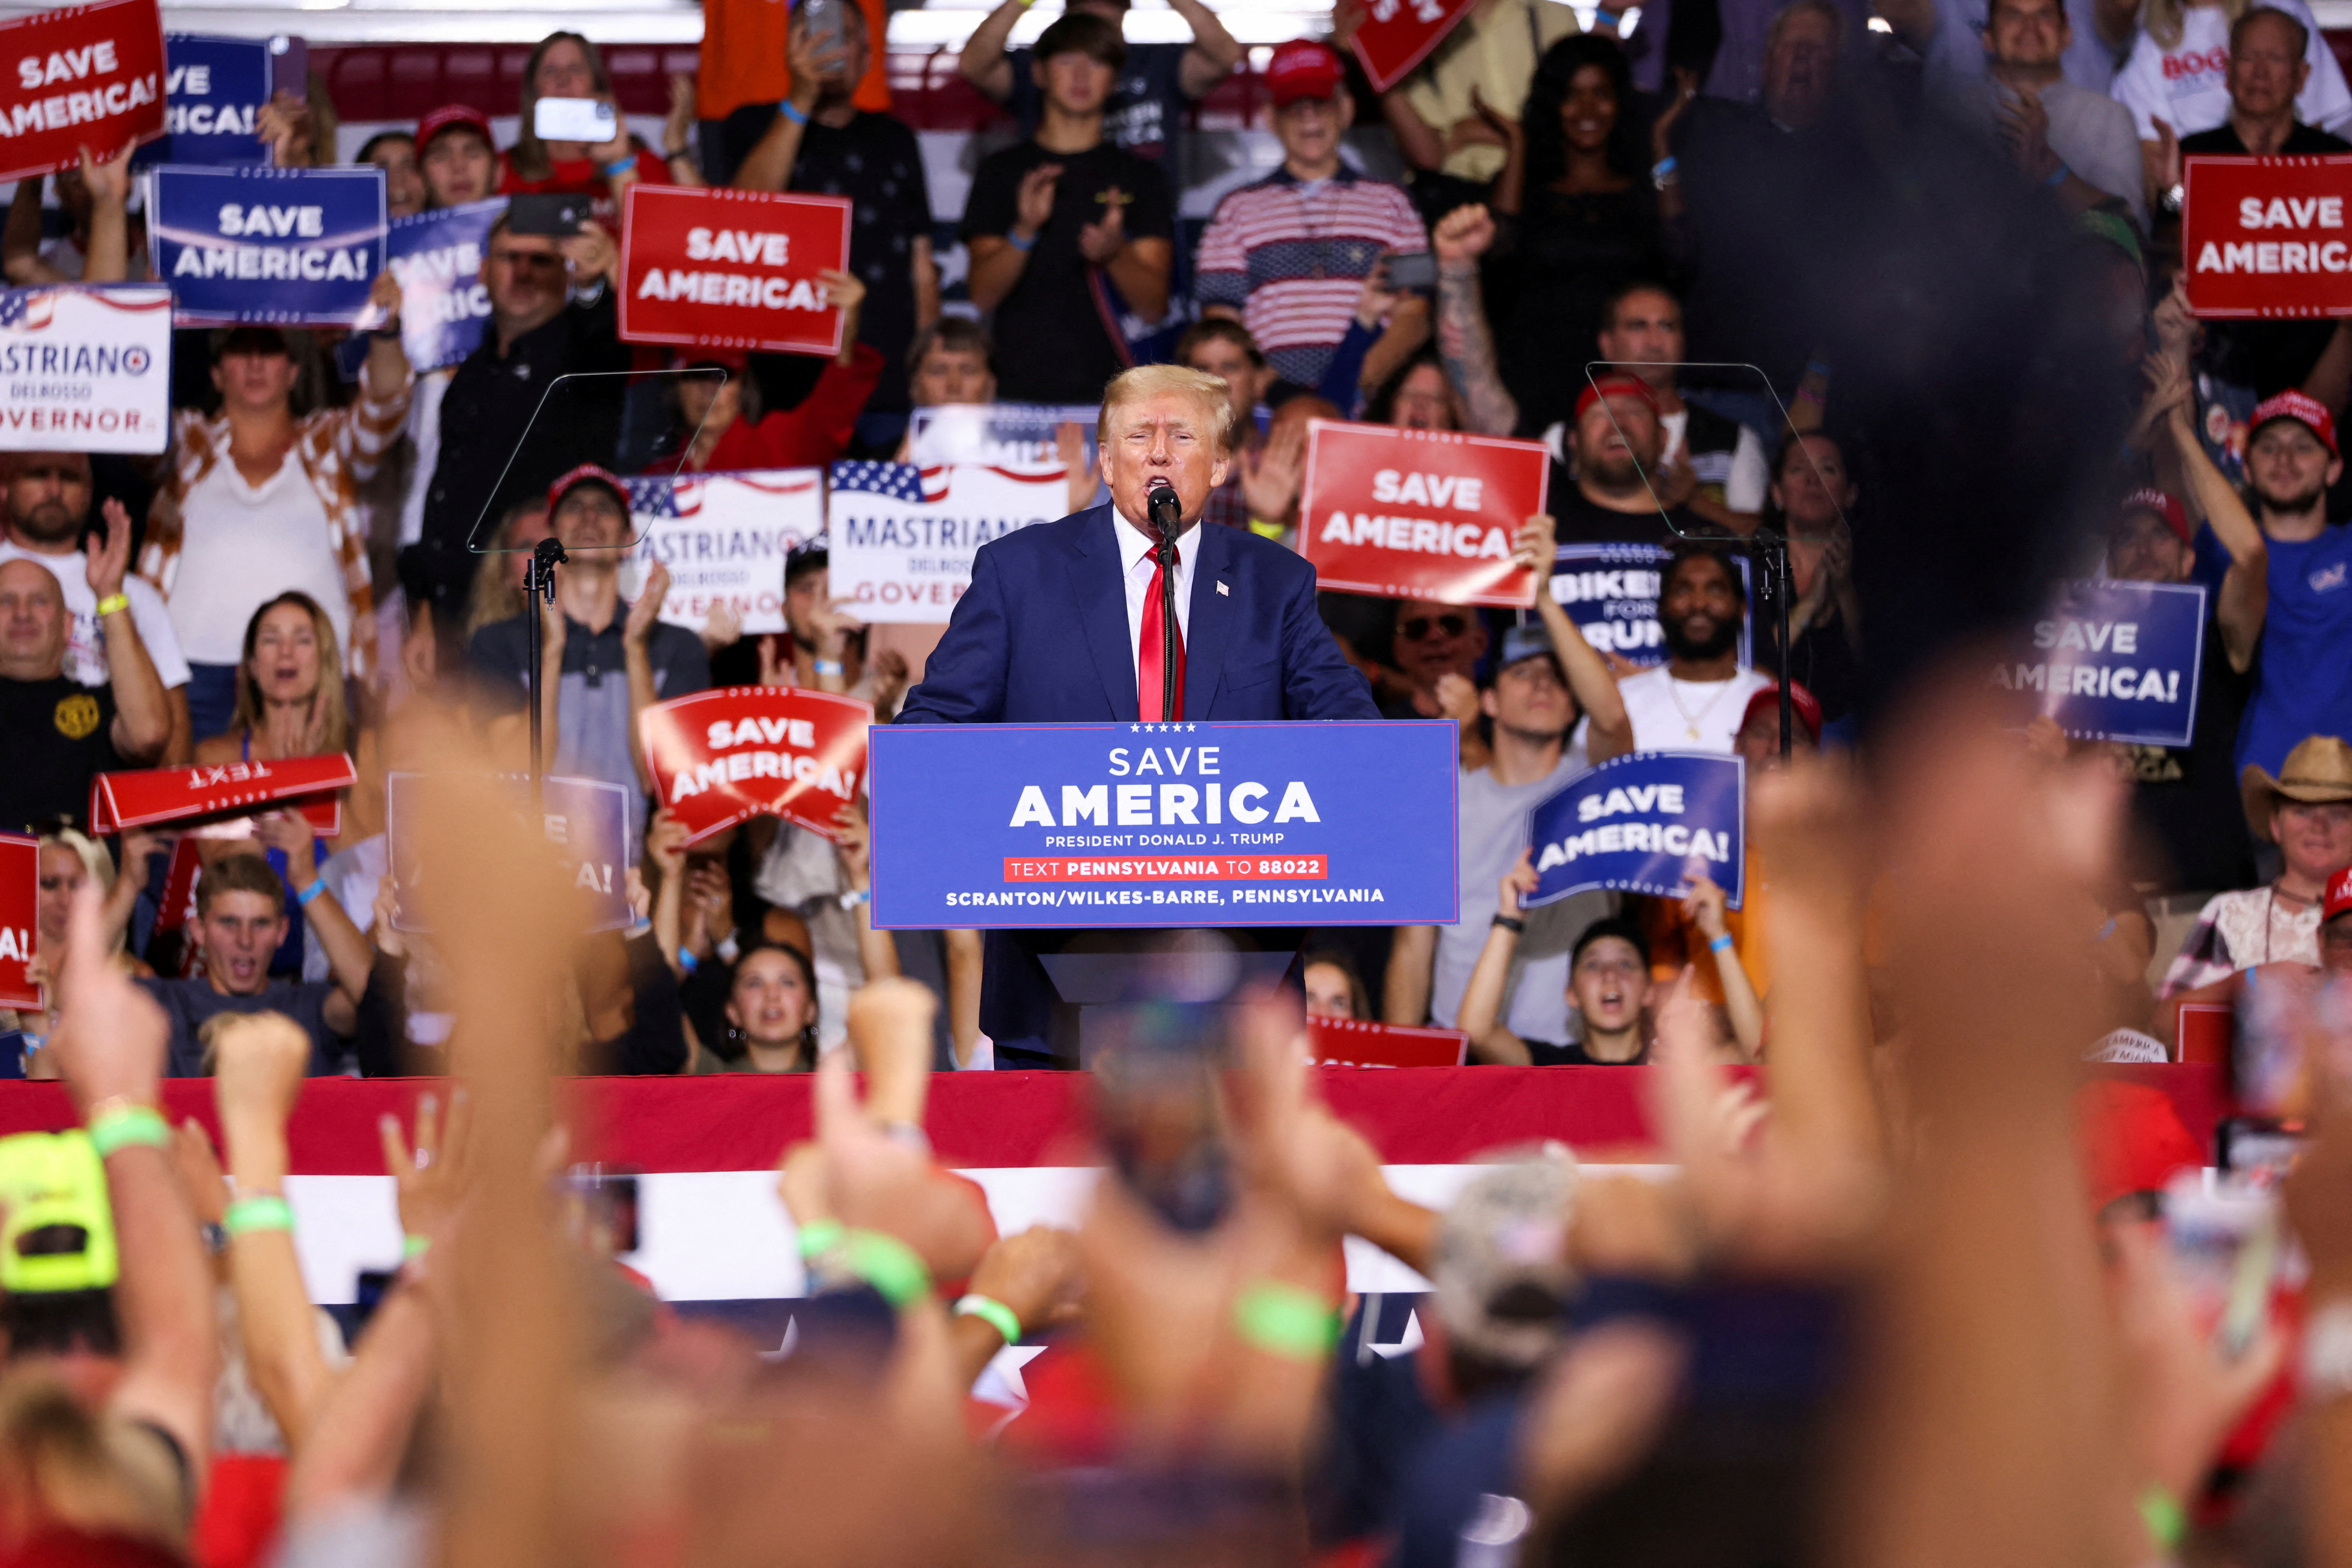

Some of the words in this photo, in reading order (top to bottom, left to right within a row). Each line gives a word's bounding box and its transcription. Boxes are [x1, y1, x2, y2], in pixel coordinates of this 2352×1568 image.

[18, 39, 119, 90] SAVE
[165, 64, 210, 95] VE
[219, 204, 324, 237] SAVE
[2239, 196, 2343, 230] SAVE
[685, 227, 790, 266] SAVE
[2196, 240, 2352, 274] AMERIC
[174, 246, 369, 281] AMERICA!
[0, 343, 151, 376] STRIANO
[11, 384, 92, 402] DELROSSO
[0, 408, 140, 432] VERNOR
[1372, 469, 1483, 512] SAVE
[846, 517, 1048, 548] MASTRIAN
[855, 581, 970, 605] GOVER
[1604, 599, 1658, 620] FOR
[2033, 620, 2138, 654] SAVE
[1989, 663, 2180, 703] AMERICA!
[708, 717, 816, 749] SAVE
[187, 759, 273, 790] TEXT
[671, 751, 855, 804] AMERICA!
[1108, 747, 1220, 777] SAVE
[1009, 781, 1321, 827] AMERICA
[1578, 784, 1685, 823] SAVE
[1046, 836, 1133, 847] PRESIDENT
[1139, 834, 1207, 846] DONALD
[1212, 833, 1225, 845] J.
[1230, 833, 1285, 845] TRUMP
[1537, 822, 1729, 873] AMERICA!
[1011, 862, 1060, 876] TEXT
[1067, 861, 1219, 876] PENNSYLVANIA
[1226, 860, 1251, 874] TO
[1259, 860, 1319, 874] 88022
[946, 889, 1225, 907] SCRANTON/WILKES-BARRE,
[1232, 888, 1385, 904] PENNSYLVANIA
